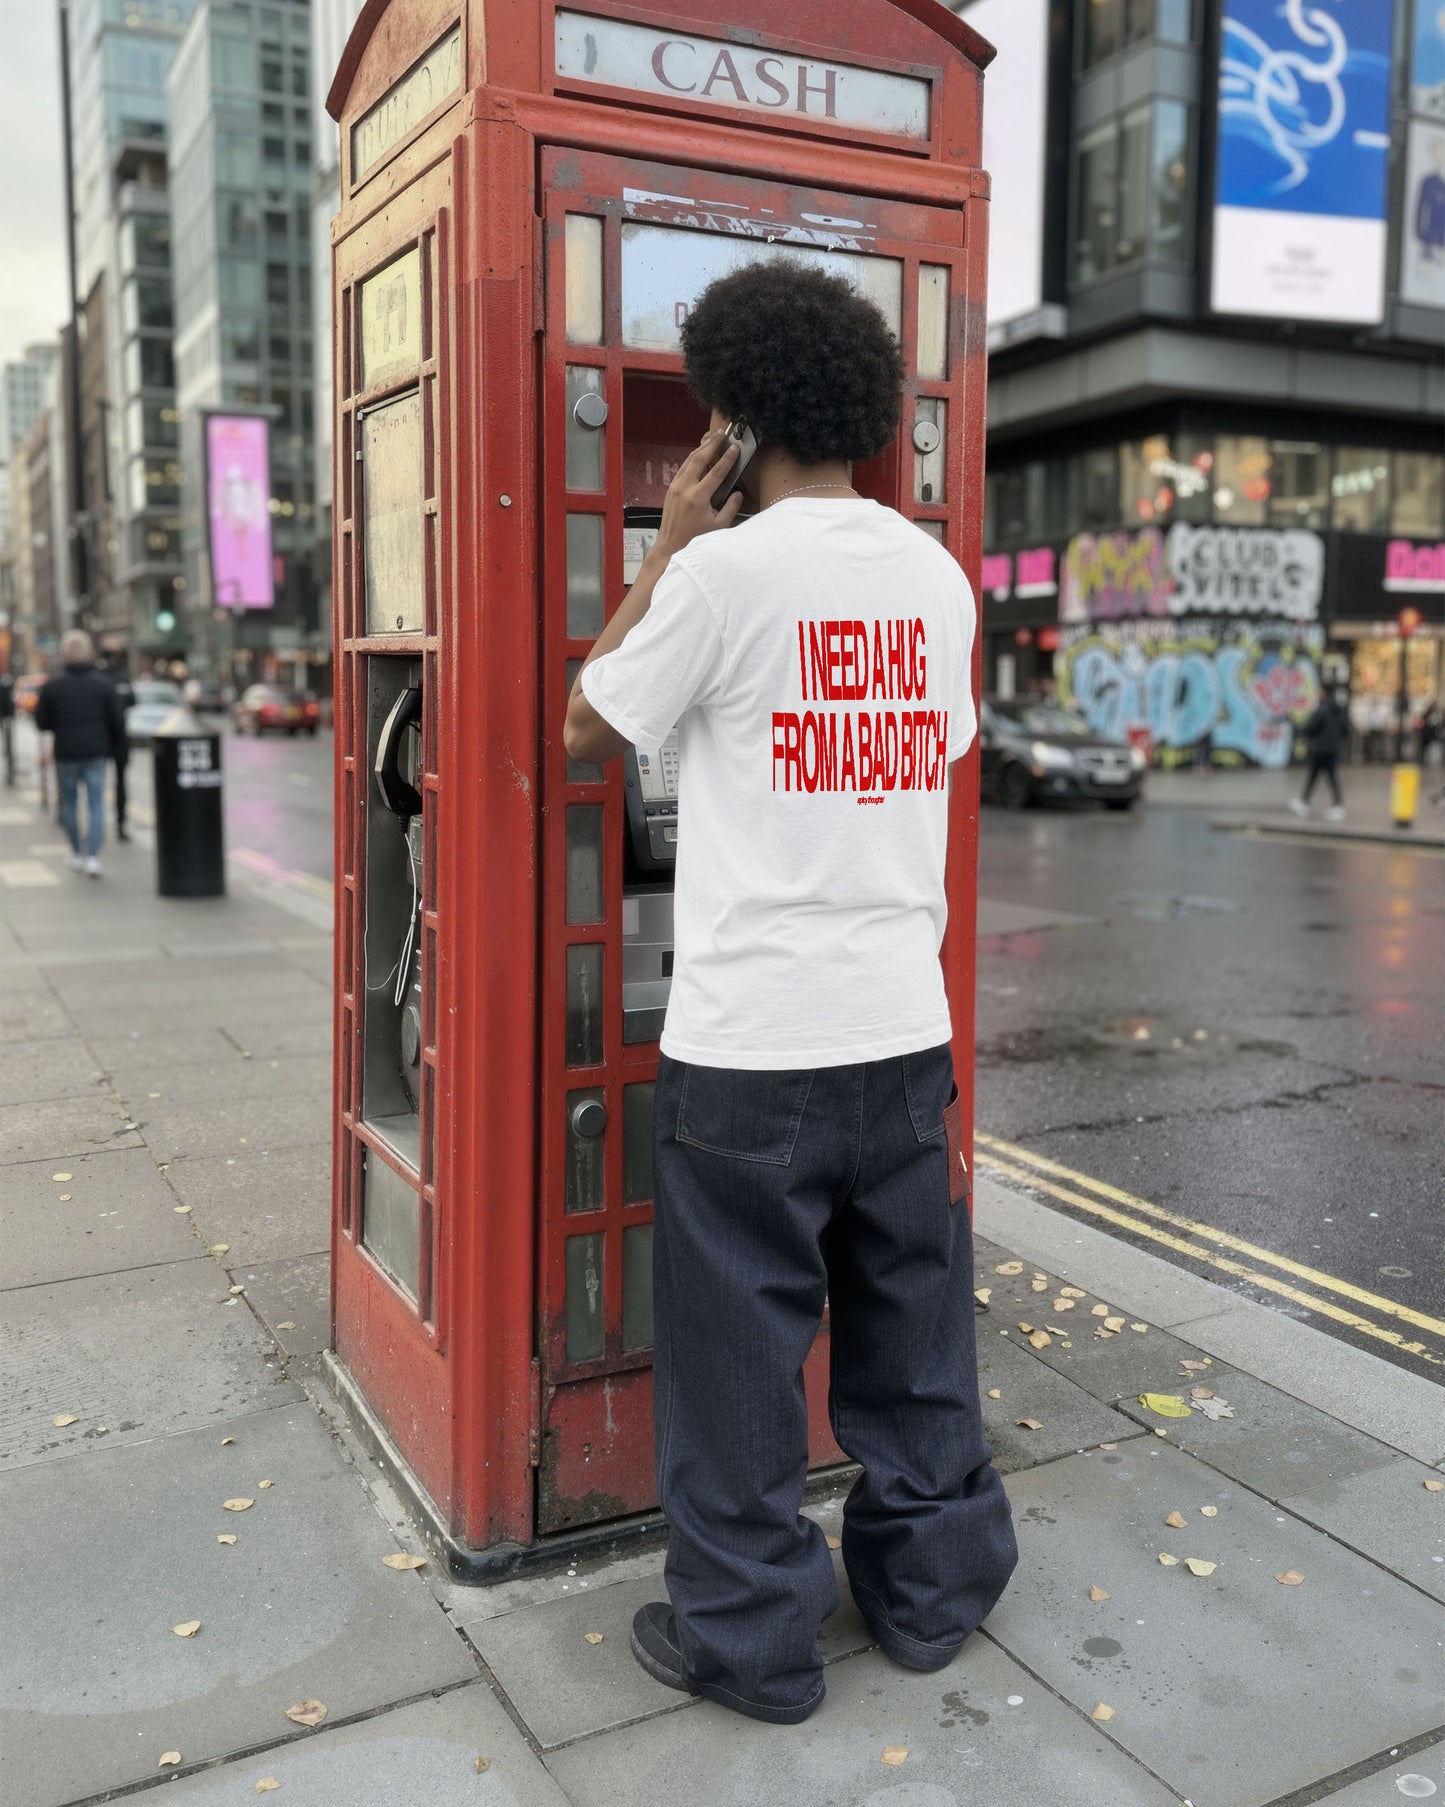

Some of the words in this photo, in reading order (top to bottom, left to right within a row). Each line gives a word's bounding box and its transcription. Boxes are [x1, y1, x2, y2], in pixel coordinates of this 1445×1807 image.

[651, 40, 838, 119] CASH
[798, 620, 808, 701] I
[809, 620, 869, 701] NEED
[872, 619, 887, 700] A
[887, 617, 926, 701] HUG
[772, 710, 838, 793] FROM
[841, 712, 857, 792] A
[858, 711, 898, 792] BAD
[900, 709, 948, 792] BITCH
